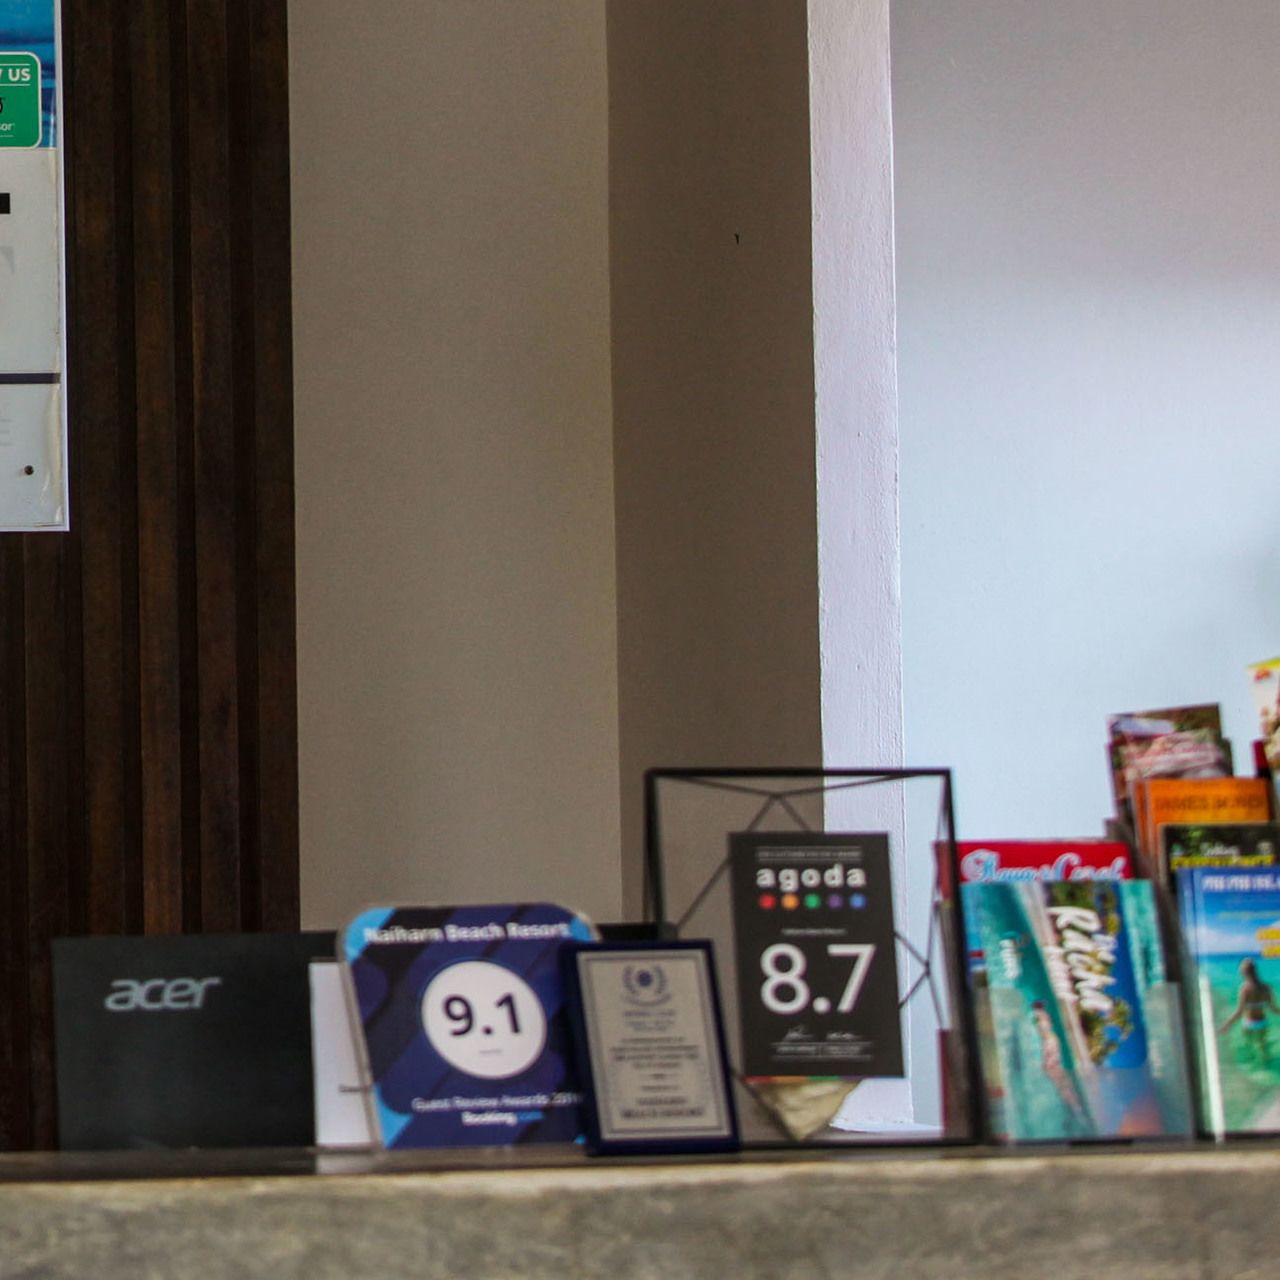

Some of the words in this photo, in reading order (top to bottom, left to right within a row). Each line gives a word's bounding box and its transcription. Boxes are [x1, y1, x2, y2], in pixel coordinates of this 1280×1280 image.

[8, 68, 31, 82] US
[756, 863, 867, 893] agoda
[364, 925, 443, 943] Naiharn
[445, 923, 505, 942] Beach
[506, 922, 570, 939] Resort
[104, 976, 221, 1011] acer
[760, 943, 876, 1014] 8.7
[443, 992, 521, 1036] 9.1
